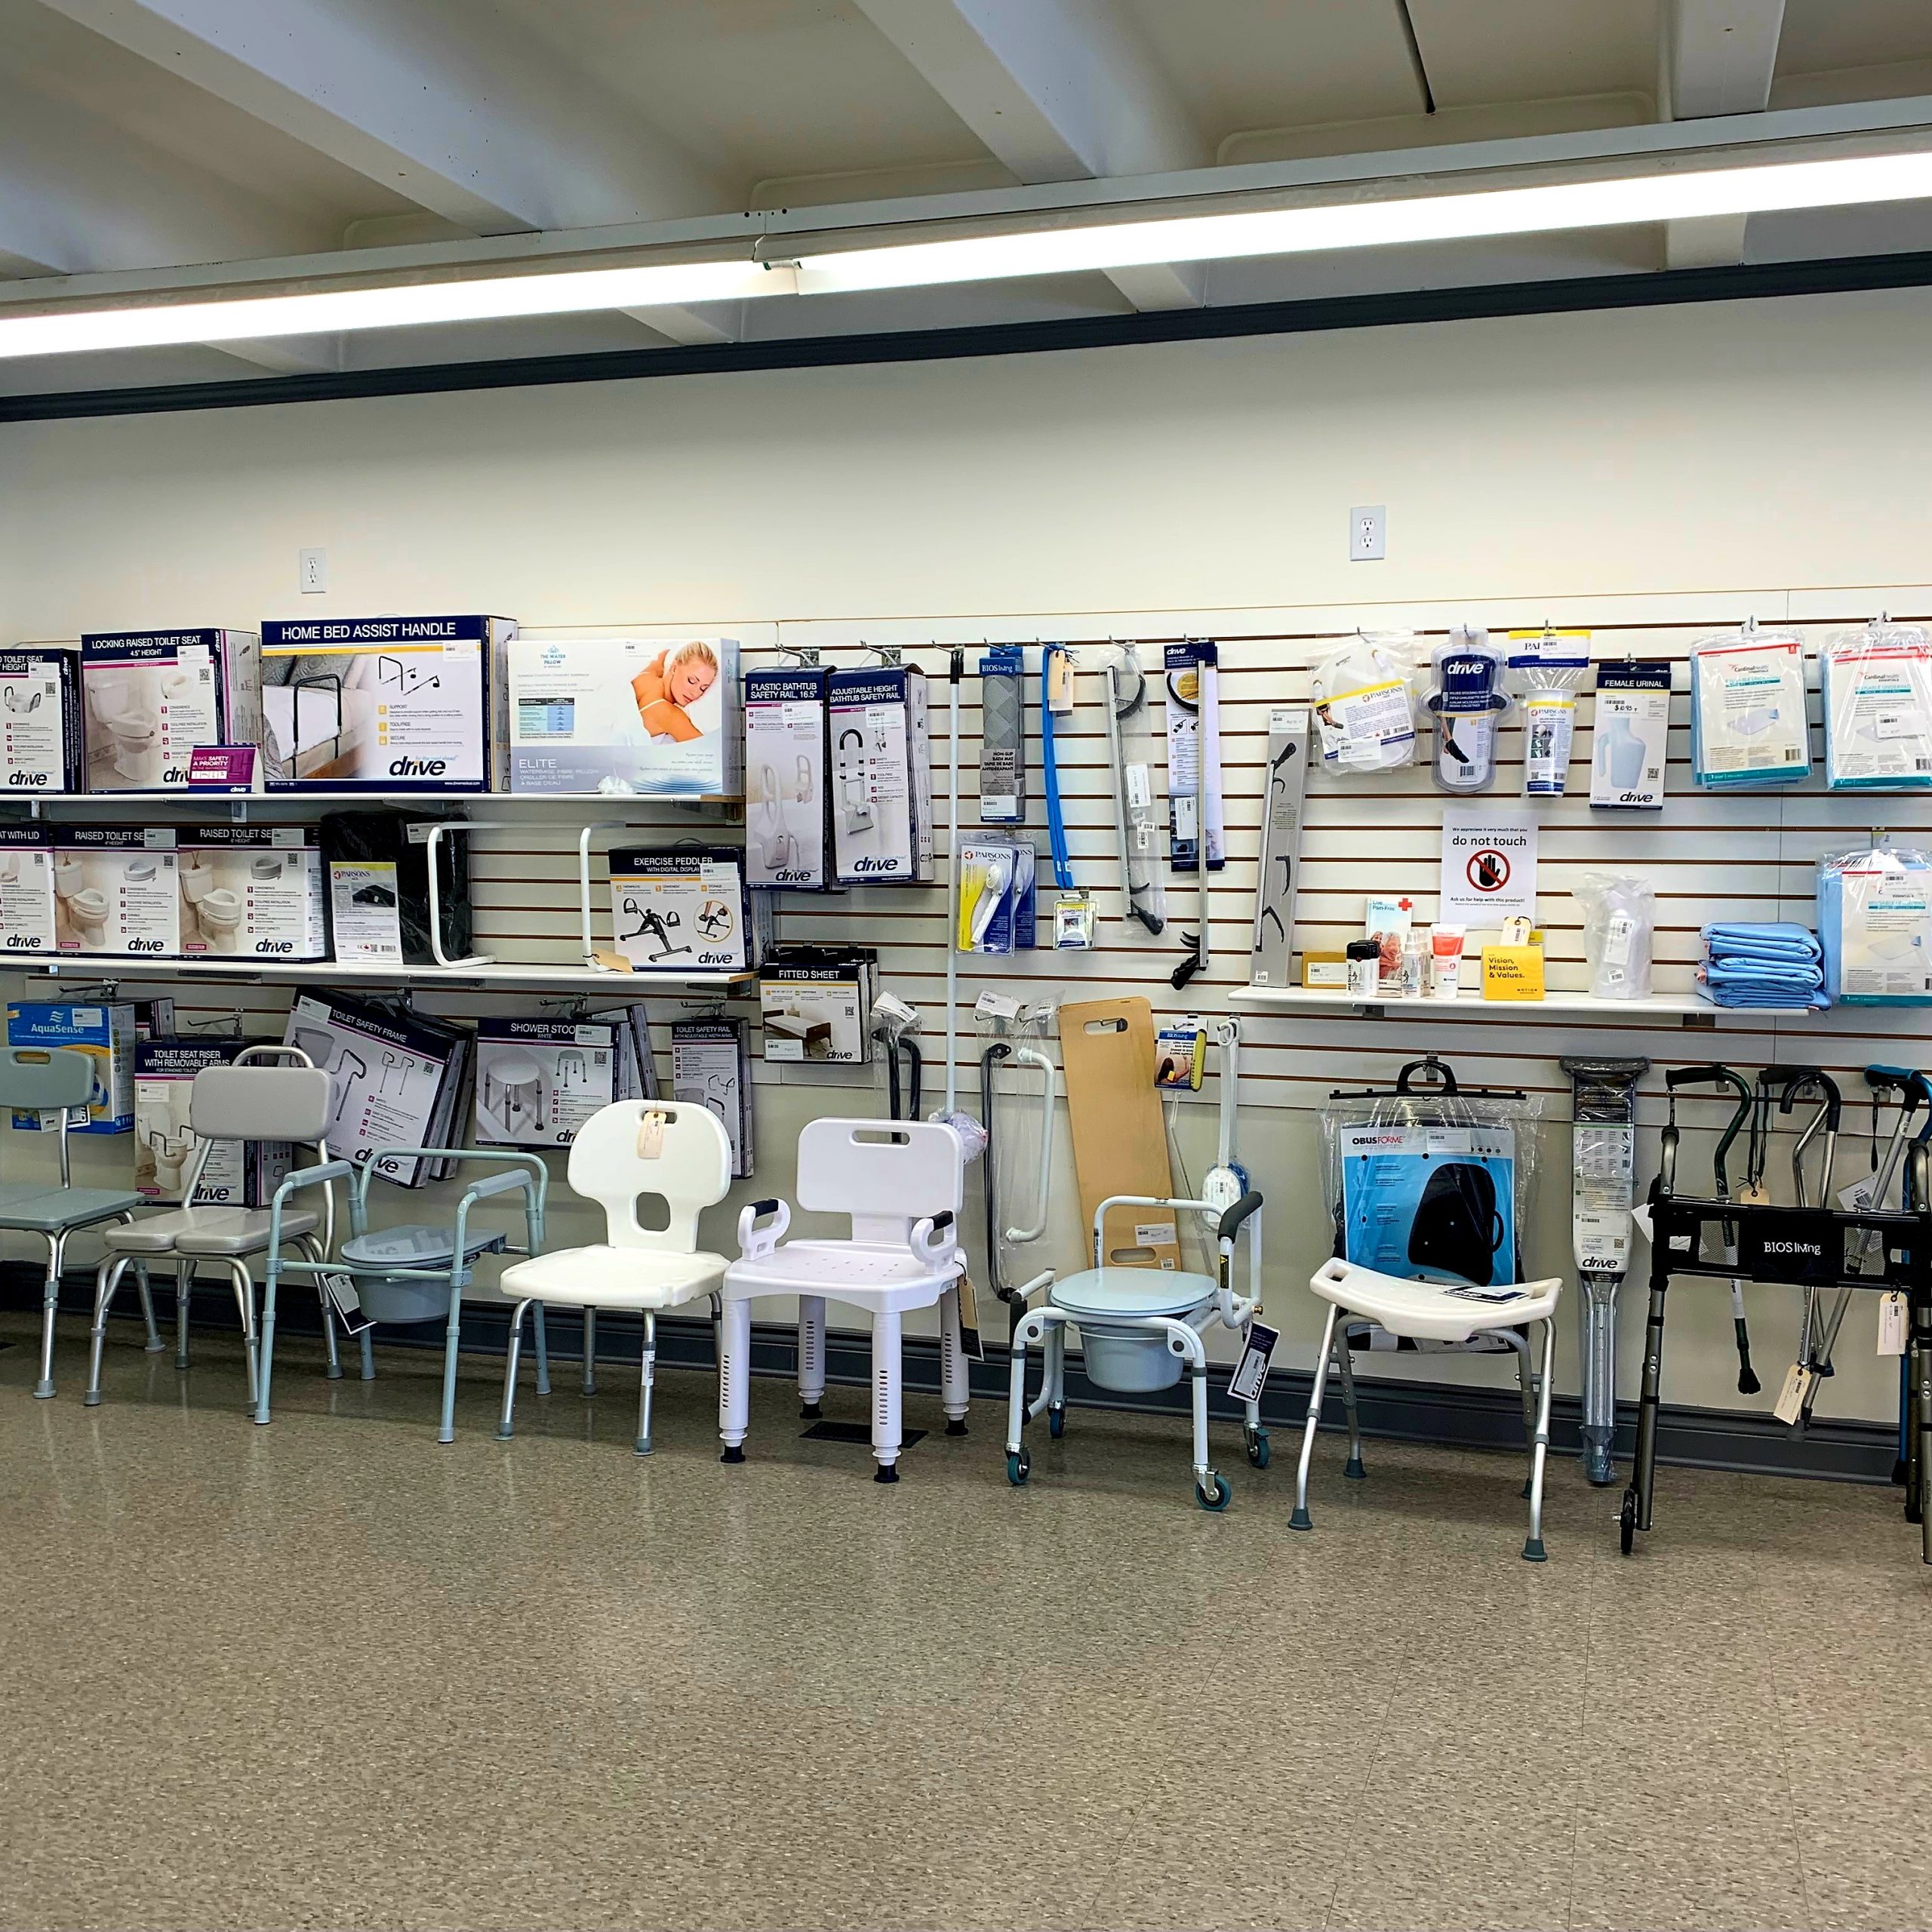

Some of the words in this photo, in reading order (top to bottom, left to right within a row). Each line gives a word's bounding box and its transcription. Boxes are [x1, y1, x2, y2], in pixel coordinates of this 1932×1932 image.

[281, 626, 320, 640] HOME
[323, 625, 349, 638] BED
[352, 623, 399, 638] ASSIST
[401, 622, 456, 636] HANDLE
[91, 639, 125, 649] LOCKING
[126, 638, 153, 648] RAISED
[154, 636, 180, 646] TOILET
[181, 635, 201, 645] SEAT
[1447, 661, 1484, 675] drive
[783, 682, 817, 691] BATHTUB
[831, 686, 872, 695] ADJUSTABLE
[873, 685, 898, 693] HEIGHT
[750, 691, 778, 699] SAFETY
[780, 691, 798, 699] RAIL,
[829, 694, 860, 703] BATHTUB
[860, 693, 885, 701] SAFETY
[1370, 687, 1403, 699] PARSONS
[389, 755, 446, 776] drive
[518, 758, 557, 768] ELITE
[9, 770, 48, 786] drive
[163, 766, 189, 783] dri
[1620, 792, 1654, 802] drive
[7, 831, 26, 839] WITH
[27, 831, 39, 839] LID
[75, 831, 103, 840] RAISED
[104, 832, 132, 841] TOILET
[134, 832, 144, 841] SE
[200, 829, 229, 838] RAISED
[231, 829, 259, 838] TOILET
[260, 829, 272, 838] SE
[1452, 835, 1467, 845] do
[1471, 837, 1491, 845] not
[1494, 836, 1527, 846] touch
[975, 851, 1011, 860] PARSONS
[634, 857, 673, 866] EXERCISE
[675, 857, 713, 866] PEDDLER
[854, 856, 898, 872] drive
[775, 869, 811, 881] drive
[7, 934, 42, 948] drive
[128, 937, 165, 952] drive
[255, 938, 293, 953] drive
[698, 952, 733, 964] drive
[779, 970, 808, 979] FITTED
[811, 970, 840, 979] SHEET
[31, 1023, 85, 1034] AquaSense
[332, 1009, 355, 1023] TOILET
[355, 1018, 383, 1033] SAFETY
[383, 1028, 408, 1043] FRAME
[510, 1023, 549, 1033] SHOWER
[551, 1024, 576, 1035] STOO
[154, 1050, 179, 1059] TOILET
[179, 1050, 198, 1059] SEAT
[199, 1051, 221, 1059] RISER
[826, 1050, 854, 1060] drive
[165, 1059, 208, 1067] REMOVABLE
[555, 1129, 578, 1143] dri
[1582, 1257, 1618, 1269] drive
